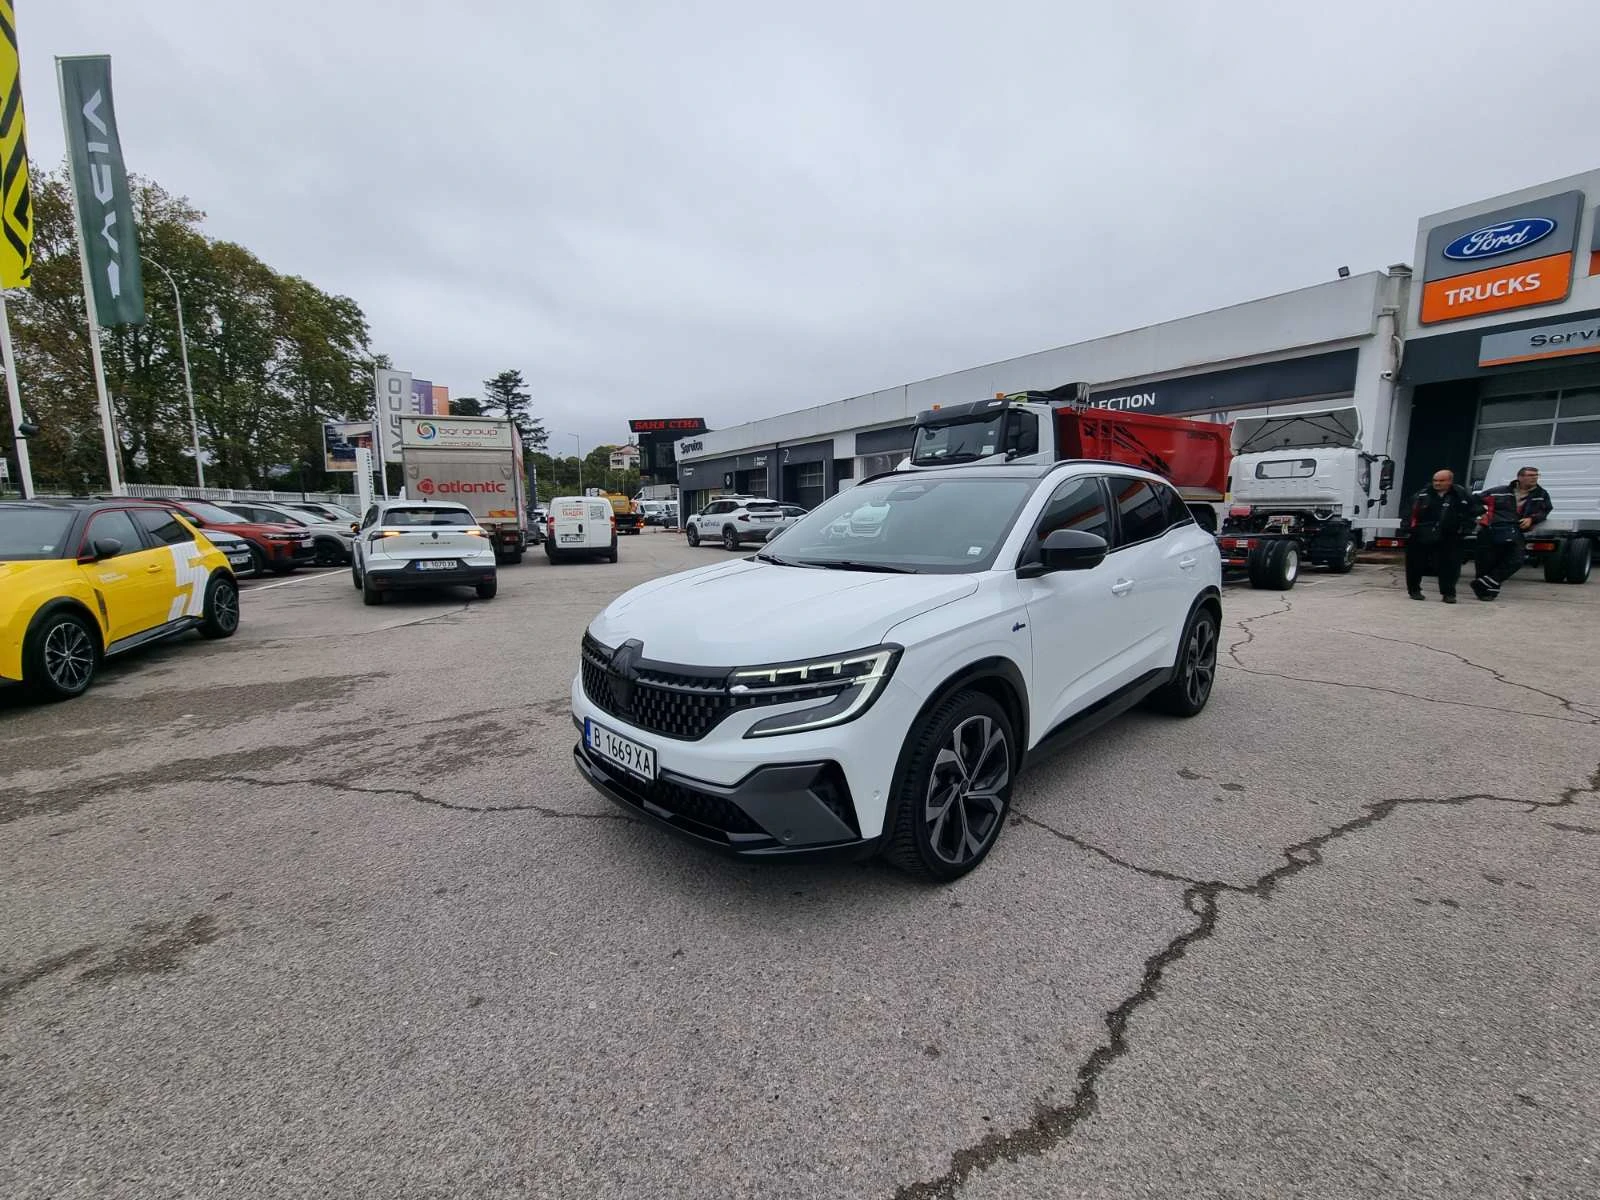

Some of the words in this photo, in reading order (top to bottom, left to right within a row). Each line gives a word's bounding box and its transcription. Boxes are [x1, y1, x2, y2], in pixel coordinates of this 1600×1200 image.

[1462, 224, 1531, 255] Ford
[1444, 272, 1542, 306] TRUCKS
[680, 439, 703, 454] Service
[783, 448, 790, 463] 2
[437, 480, 507, 494] atlantic
[594, 727, 601, 748] B
[606, 734, 632, 765] 1669
[634, 746, 651, 776] XA
